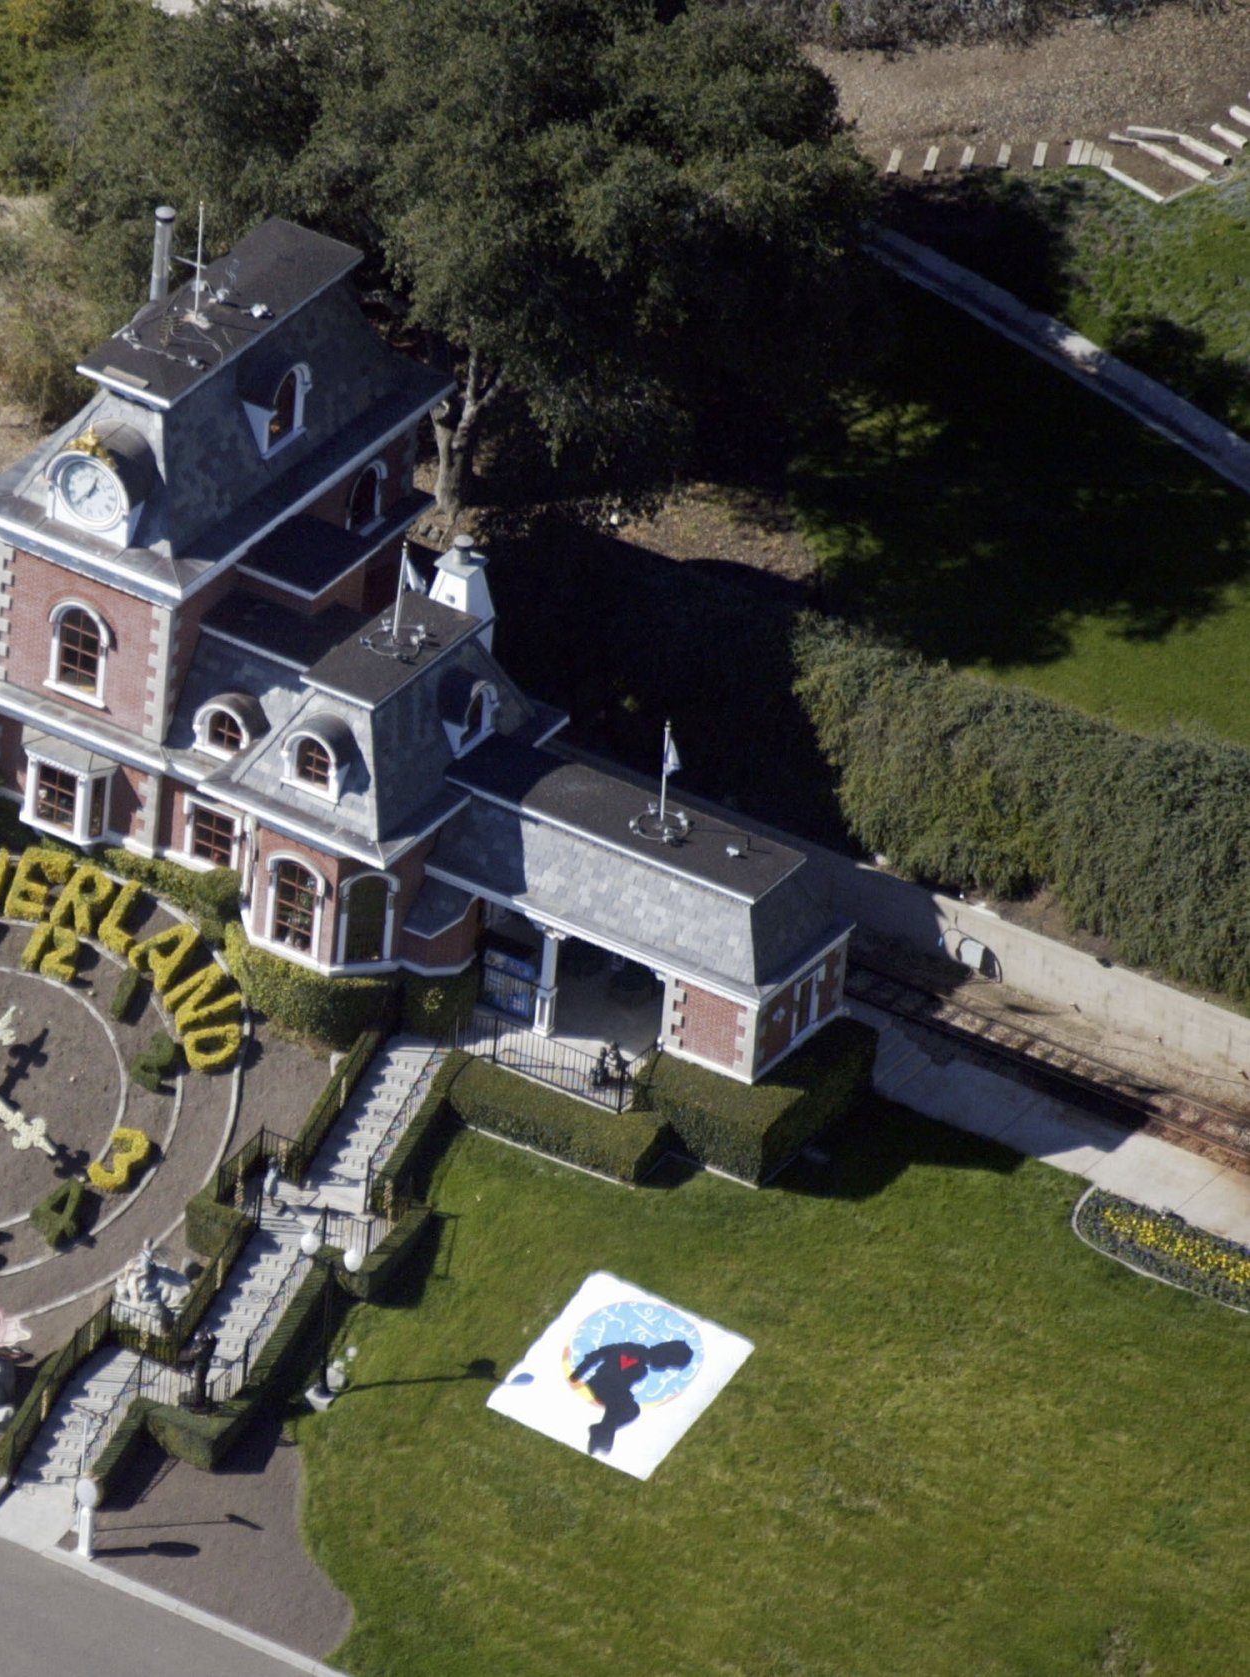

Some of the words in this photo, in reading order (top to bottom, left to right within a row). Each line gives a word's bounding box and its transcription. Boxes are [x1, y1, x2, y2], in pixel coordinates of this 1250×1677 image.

[21, 920, 79, 981] 12
[131, 1030, 175, 1092] 2
[87, 1127, 149, 1190] 3
[29, 1177, 83, 1250] 4
